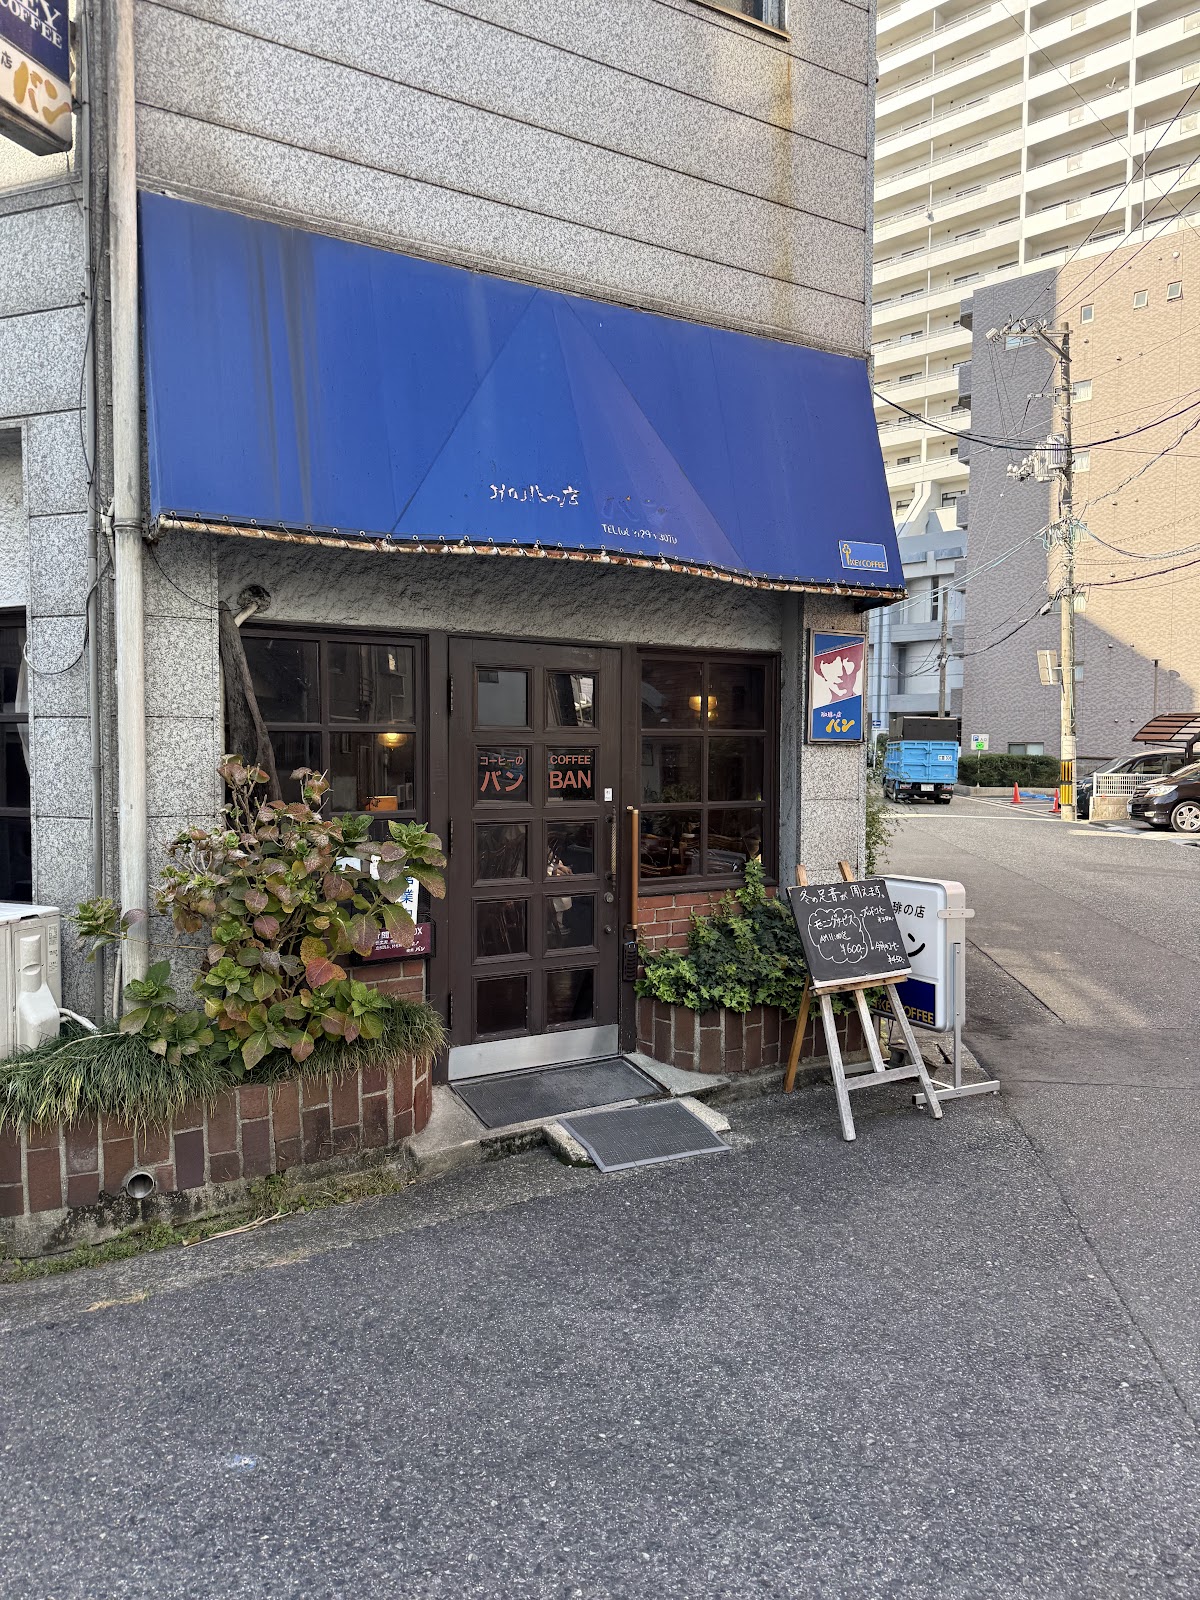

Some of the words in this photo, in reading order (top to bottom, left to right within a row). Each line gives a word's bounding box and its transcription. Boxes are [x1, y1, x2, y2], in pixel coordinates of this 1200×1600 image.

[861, 559, 886, 569] COFFEE
[480, 756, 524, 766] コーヒーの
[549, 755, 591, 765] COFFEE
[549, 770, 592, 789] BAN
[892, 901, 926, 919] 琲の店
[902, 1005, 935, 1025] OFFEE
